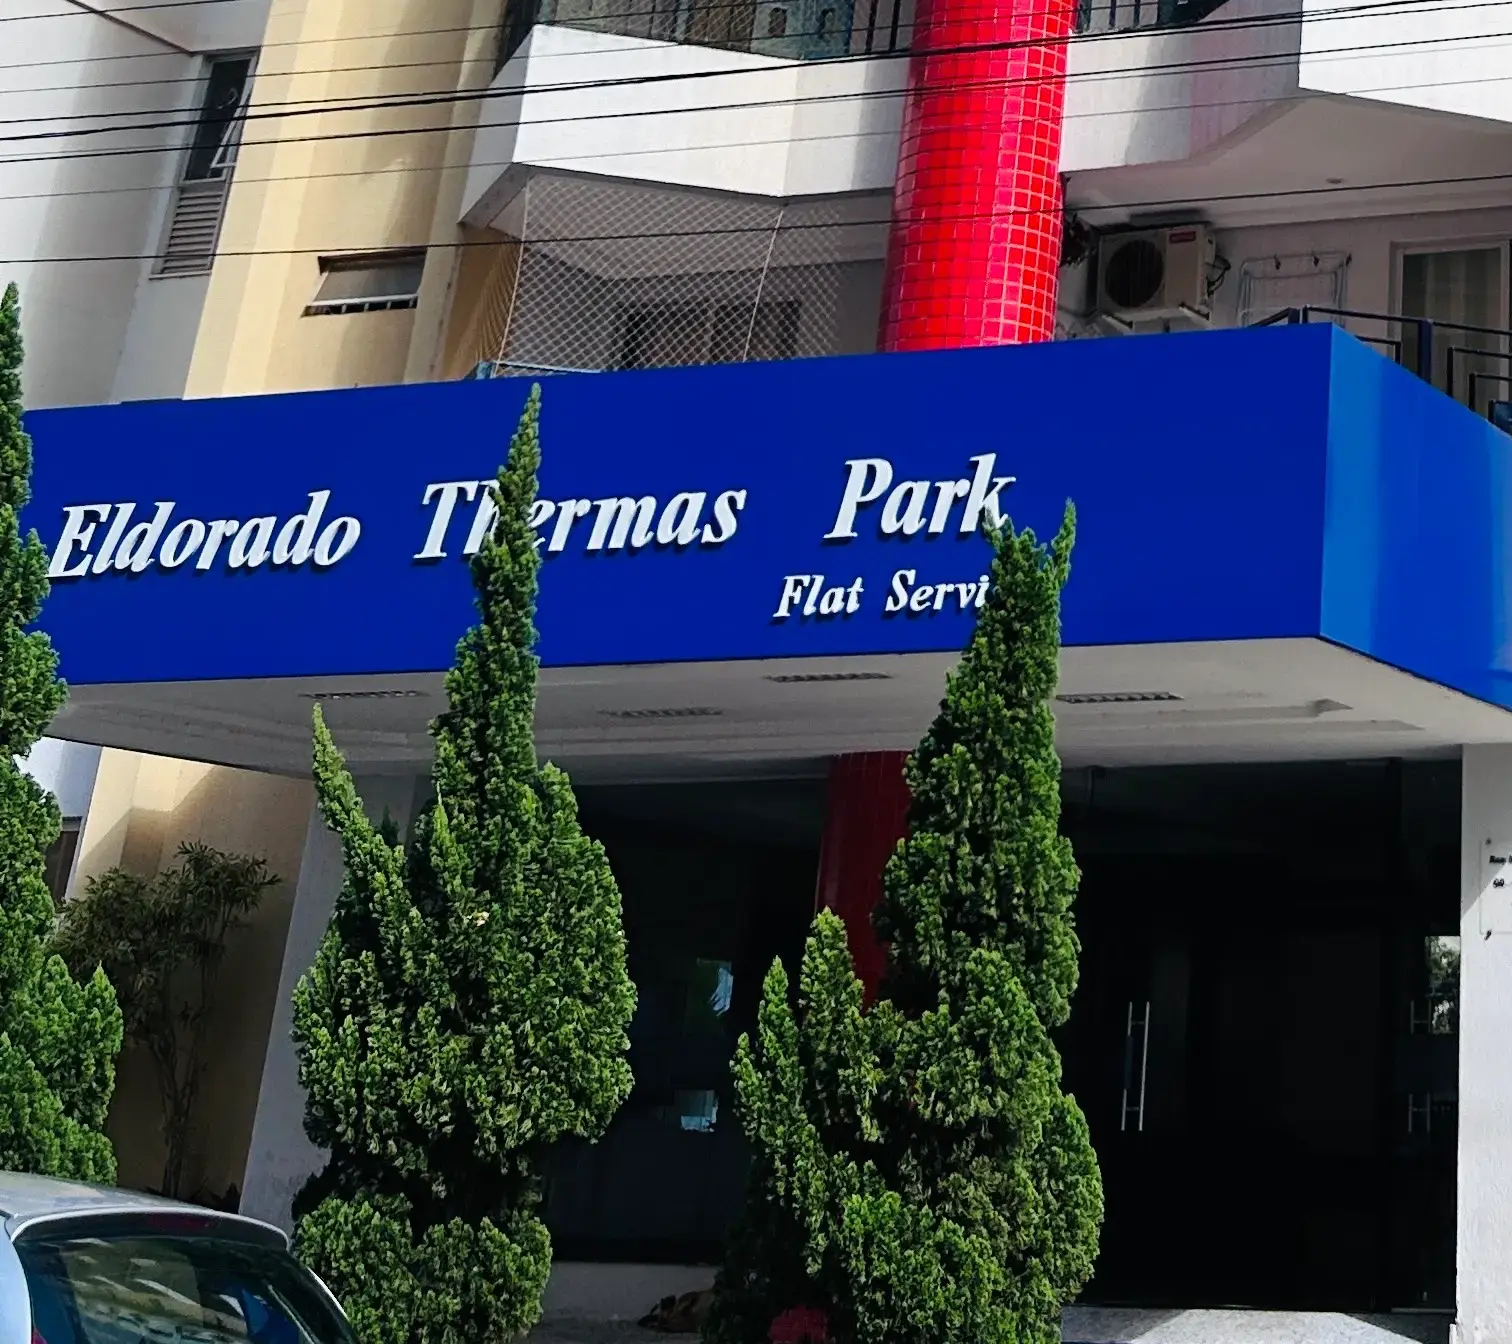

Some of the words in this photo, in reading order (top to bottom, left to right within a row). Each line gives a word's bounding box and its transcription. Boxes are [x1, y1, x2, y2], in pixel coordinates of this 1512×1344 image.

[44, 489, 361, 578] Eldorado
[413, 479, 747, 560] Thermas
[823, 452, 1017, 539] Park
[773, 574, 864, 618] Flat
[885, 568, 991, 612] Servi
